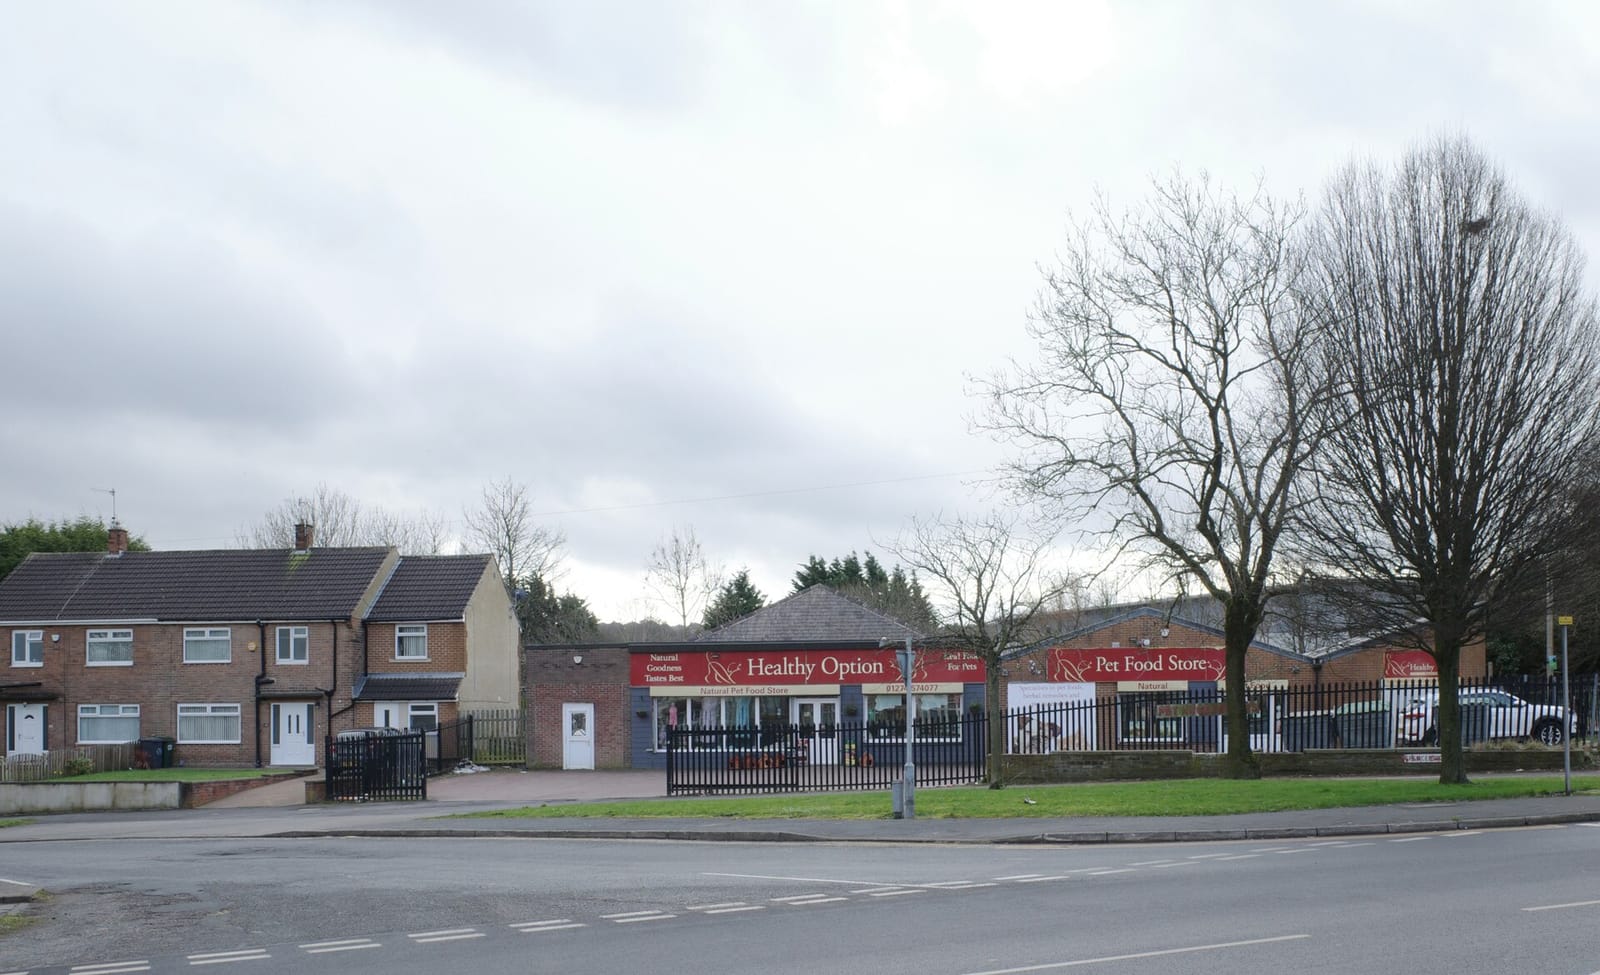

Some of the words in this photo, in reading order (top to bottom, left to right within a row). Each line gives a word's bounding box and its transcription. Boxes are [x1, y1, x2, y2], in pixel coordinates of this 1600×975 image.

[947, 663, 959, 671] For
[962, 662, 977, 671] Pets
[1096, 656, 1119, 672] Pet
[1124, 654, 1163, 672] Food
[1168, 654, 1207, 671] Store
[1409, 663, 1435, 672] Healthy
[646, 664, 682, 672] Goodness
[747, 656, 816, 681] Healthy
[821, 656, 884, 680] Option
[644, 674, 667, 682] Tastes
[668, 674, 684, 682] Best
[700, 687, 729, 695] Natural
[767, 686, 789, 694] Store
[1138, 682, 1168, 690] Natural
